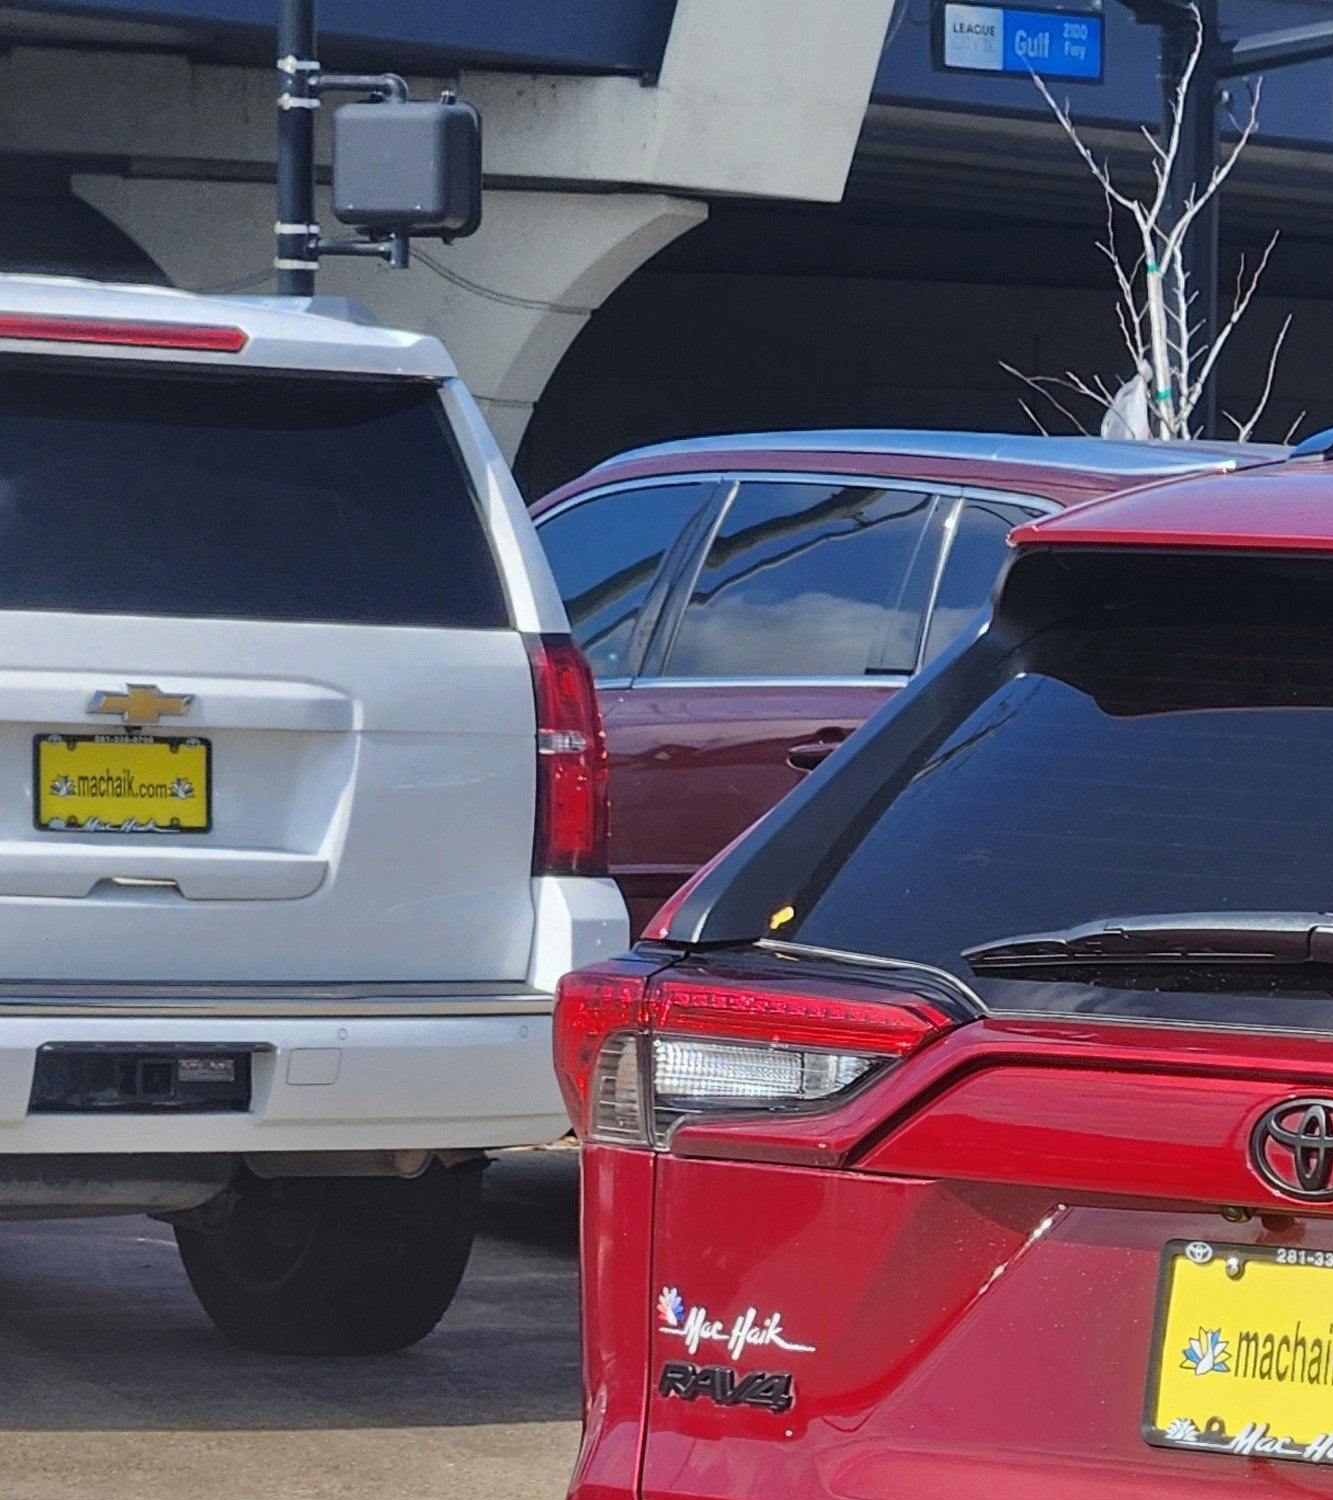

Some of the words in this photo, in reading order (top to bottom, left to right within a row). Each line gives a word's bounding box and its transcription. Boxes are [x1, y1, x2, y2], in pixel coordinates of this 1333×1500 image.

[1014, 29, 1050, 59] Gulf
[77, 769, 168, 798] machaik.com
[658, 1306, 730, 1354] Mac
[727, 1307, 816, 1360] Haik
[658, 1360, 794, 1414] RAV4
